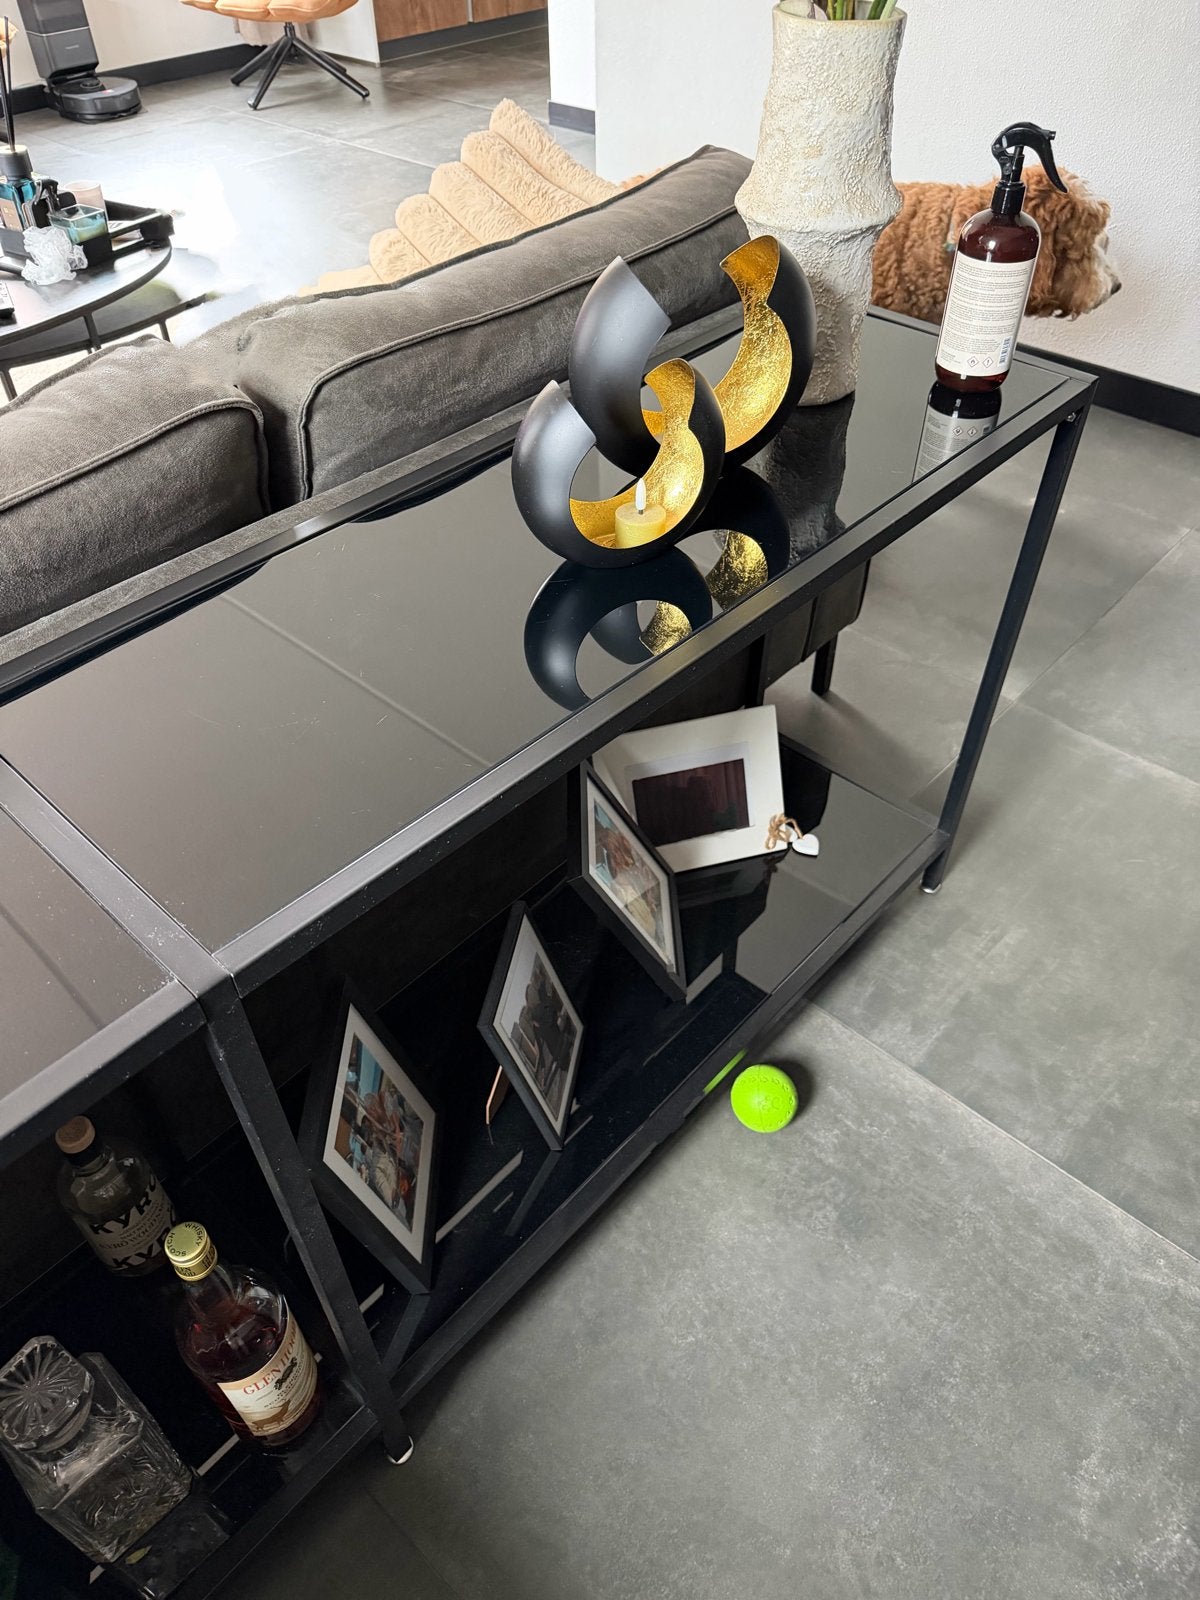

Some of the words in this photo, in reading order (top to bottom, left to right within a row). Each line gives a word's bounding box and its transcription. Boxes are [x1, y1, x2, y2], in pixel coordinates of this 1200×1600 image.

[167, 1232, 187, 1257] SCOTCH
[184, 1223, 203, 1247] WHISKY
[243, 1367, 281, 1395] GLEN
